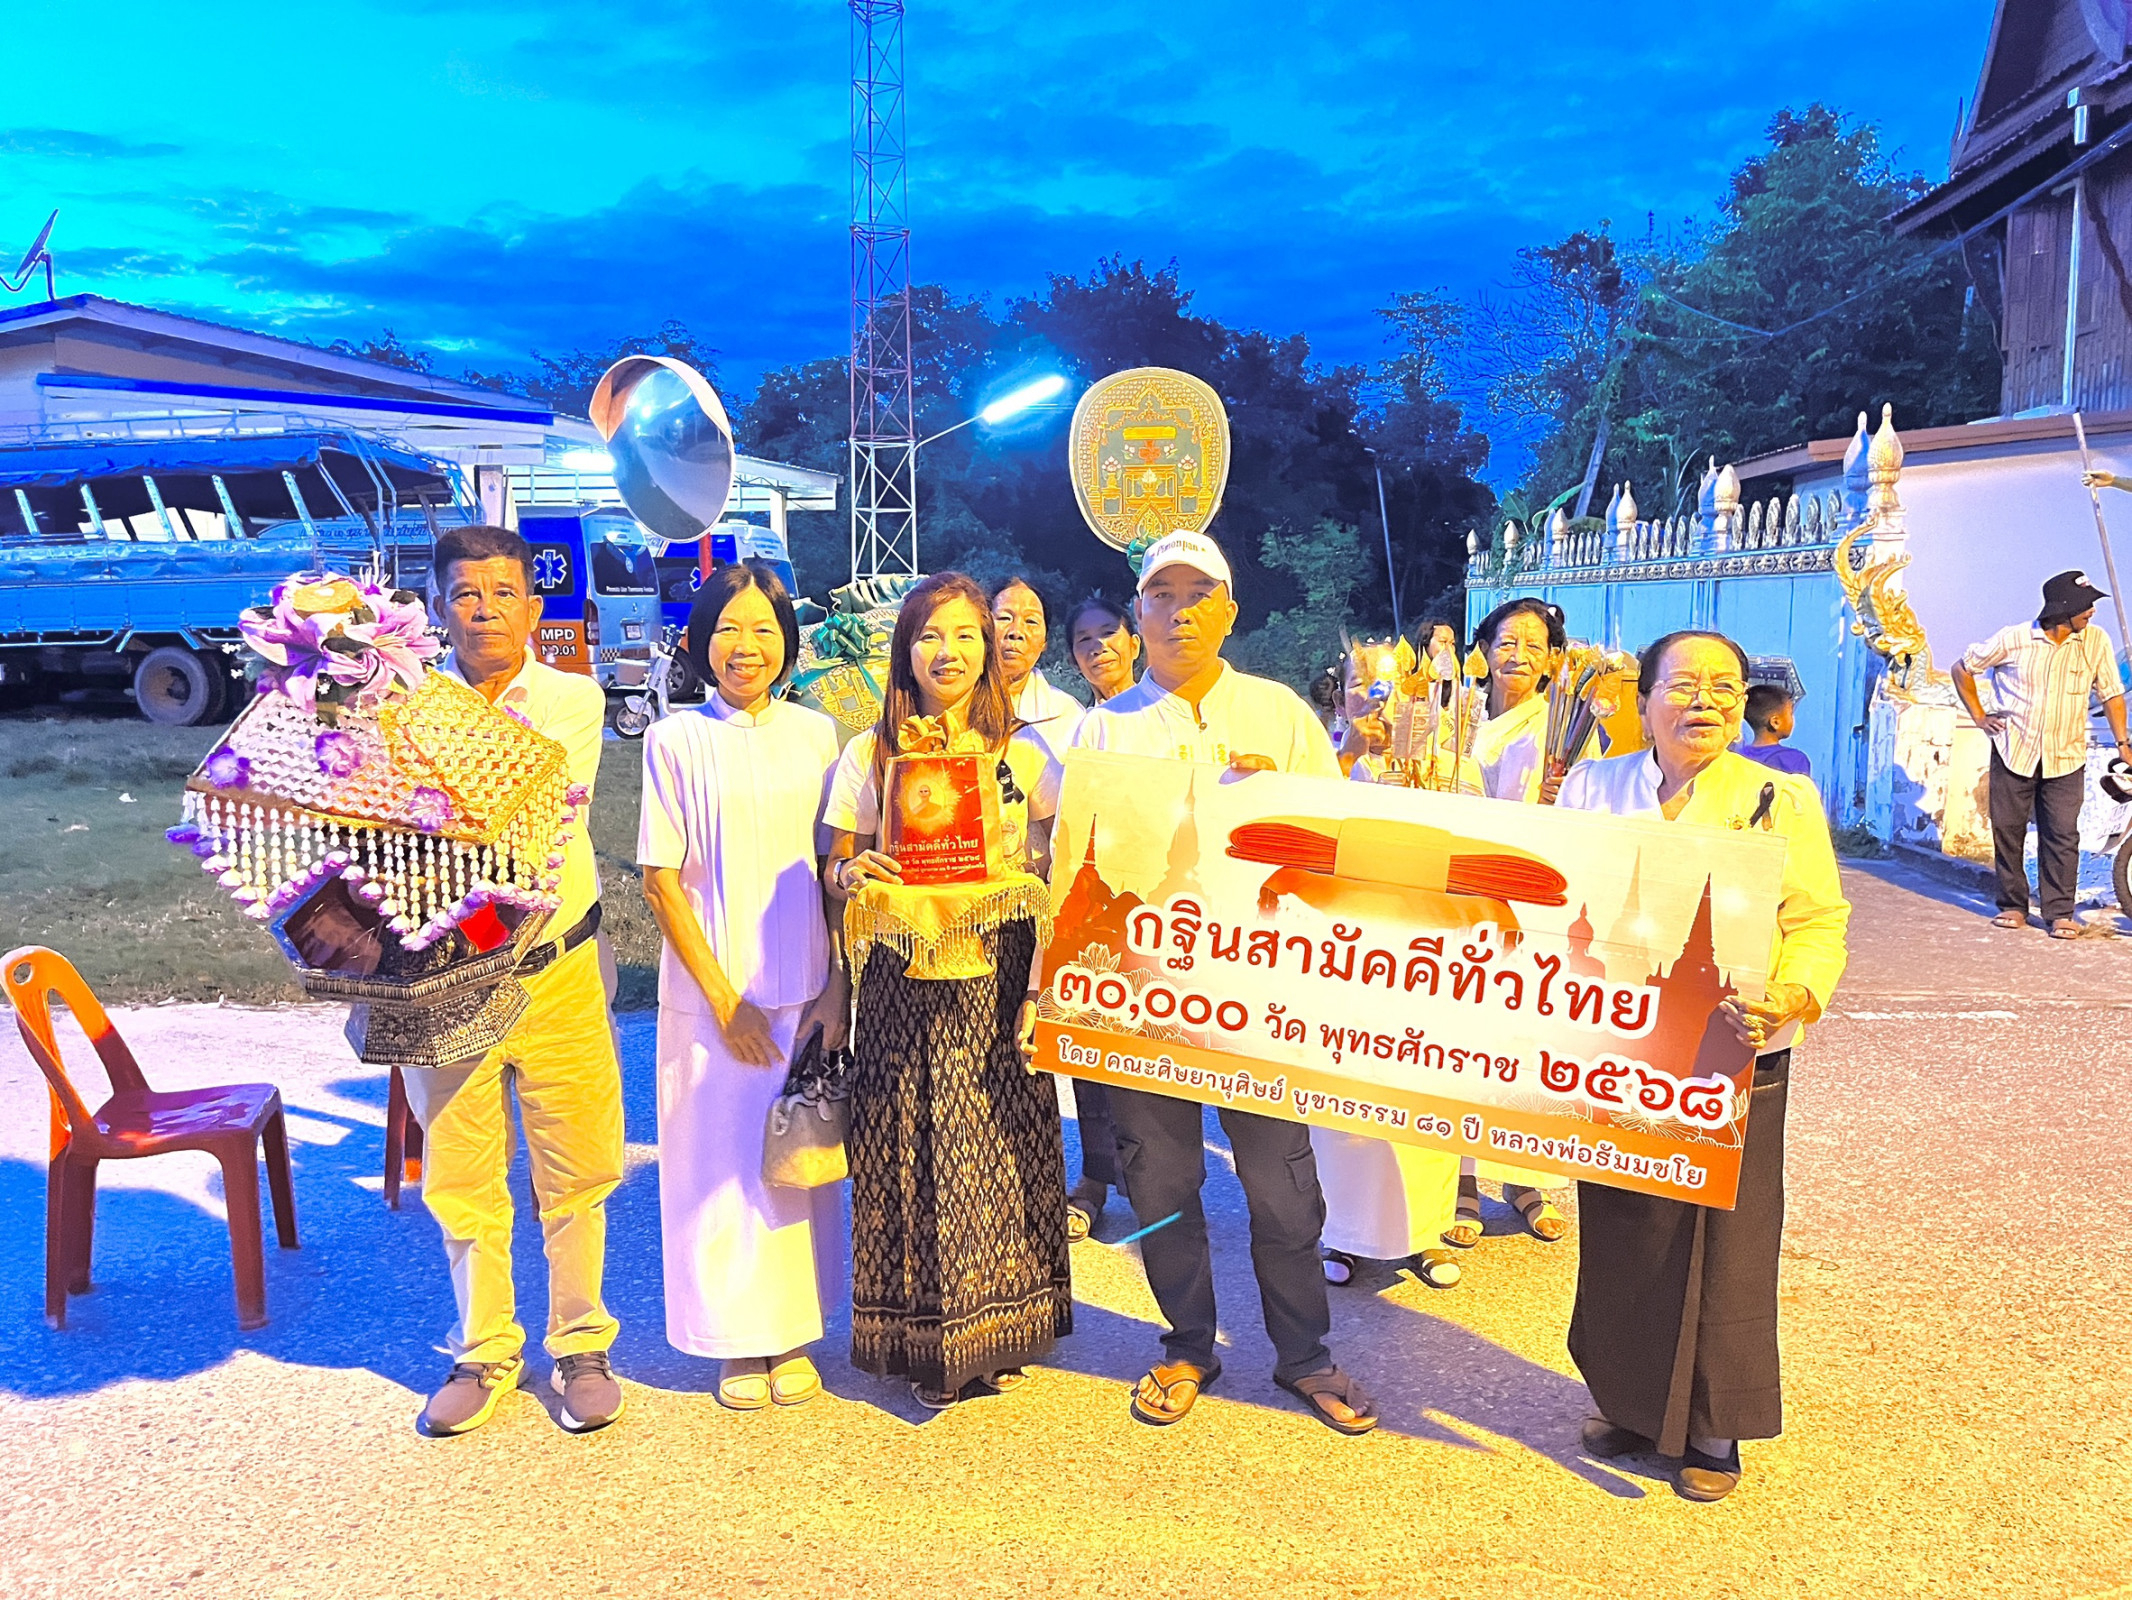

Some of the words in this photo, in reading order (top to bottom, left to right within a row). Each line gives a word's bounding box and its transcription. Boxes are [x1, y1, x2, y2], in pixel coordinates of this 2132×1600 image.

[541, 628, 575, 640] MPD
[1134, 900, 1650, 1030] กฐินสามัคคีทั่วไทย
[1060, 972, 1248, 1031] ๓๐,๐๐๐
[1265, 1003, 1306, 1043] วัด
[1320, 1024, 1520, 1082] พุทธศักราช
[1539, 1051, 1726, 1121] ๒๕๖๘
[1060, 1038, 1098, 1065] โดย
[1107, 1054, 1284, 1101] คณะศิษยานุศิษย์
[1294, 1090, 1406, 1126] บูชาธรรม
[1417, 1116, 1451, 1136] ๘๑
[1463, 1117, 1480, 1140] ปี
[1491, 1129, 1703, 1185] หลวงพ่อธัมมชโย
